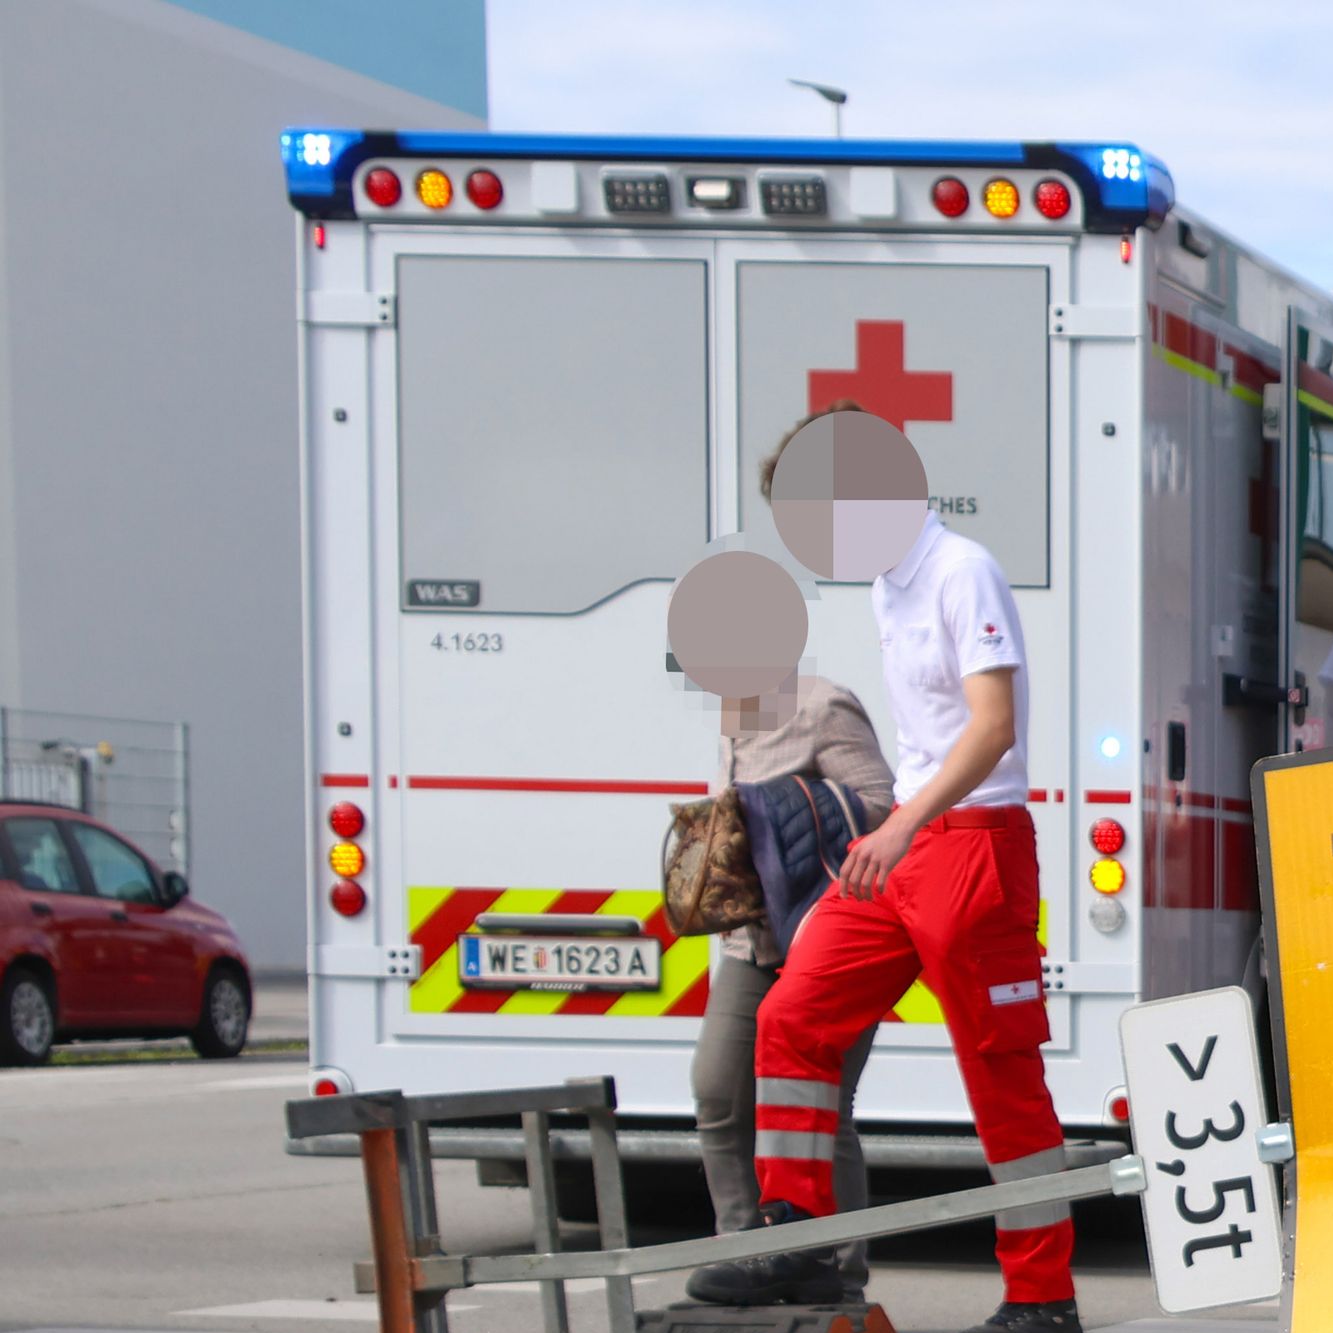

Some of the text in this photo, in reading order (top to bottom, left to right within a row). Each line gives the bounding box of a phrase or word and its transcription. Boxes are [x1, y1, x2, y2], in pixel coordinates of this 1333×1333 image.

[415, 583, 469, 602] WAS
[430, 632, 503, 652] 4.1623
[487, 944, 527, 973] WE
[1156, 1100, 1256, 1268] 3,5t
